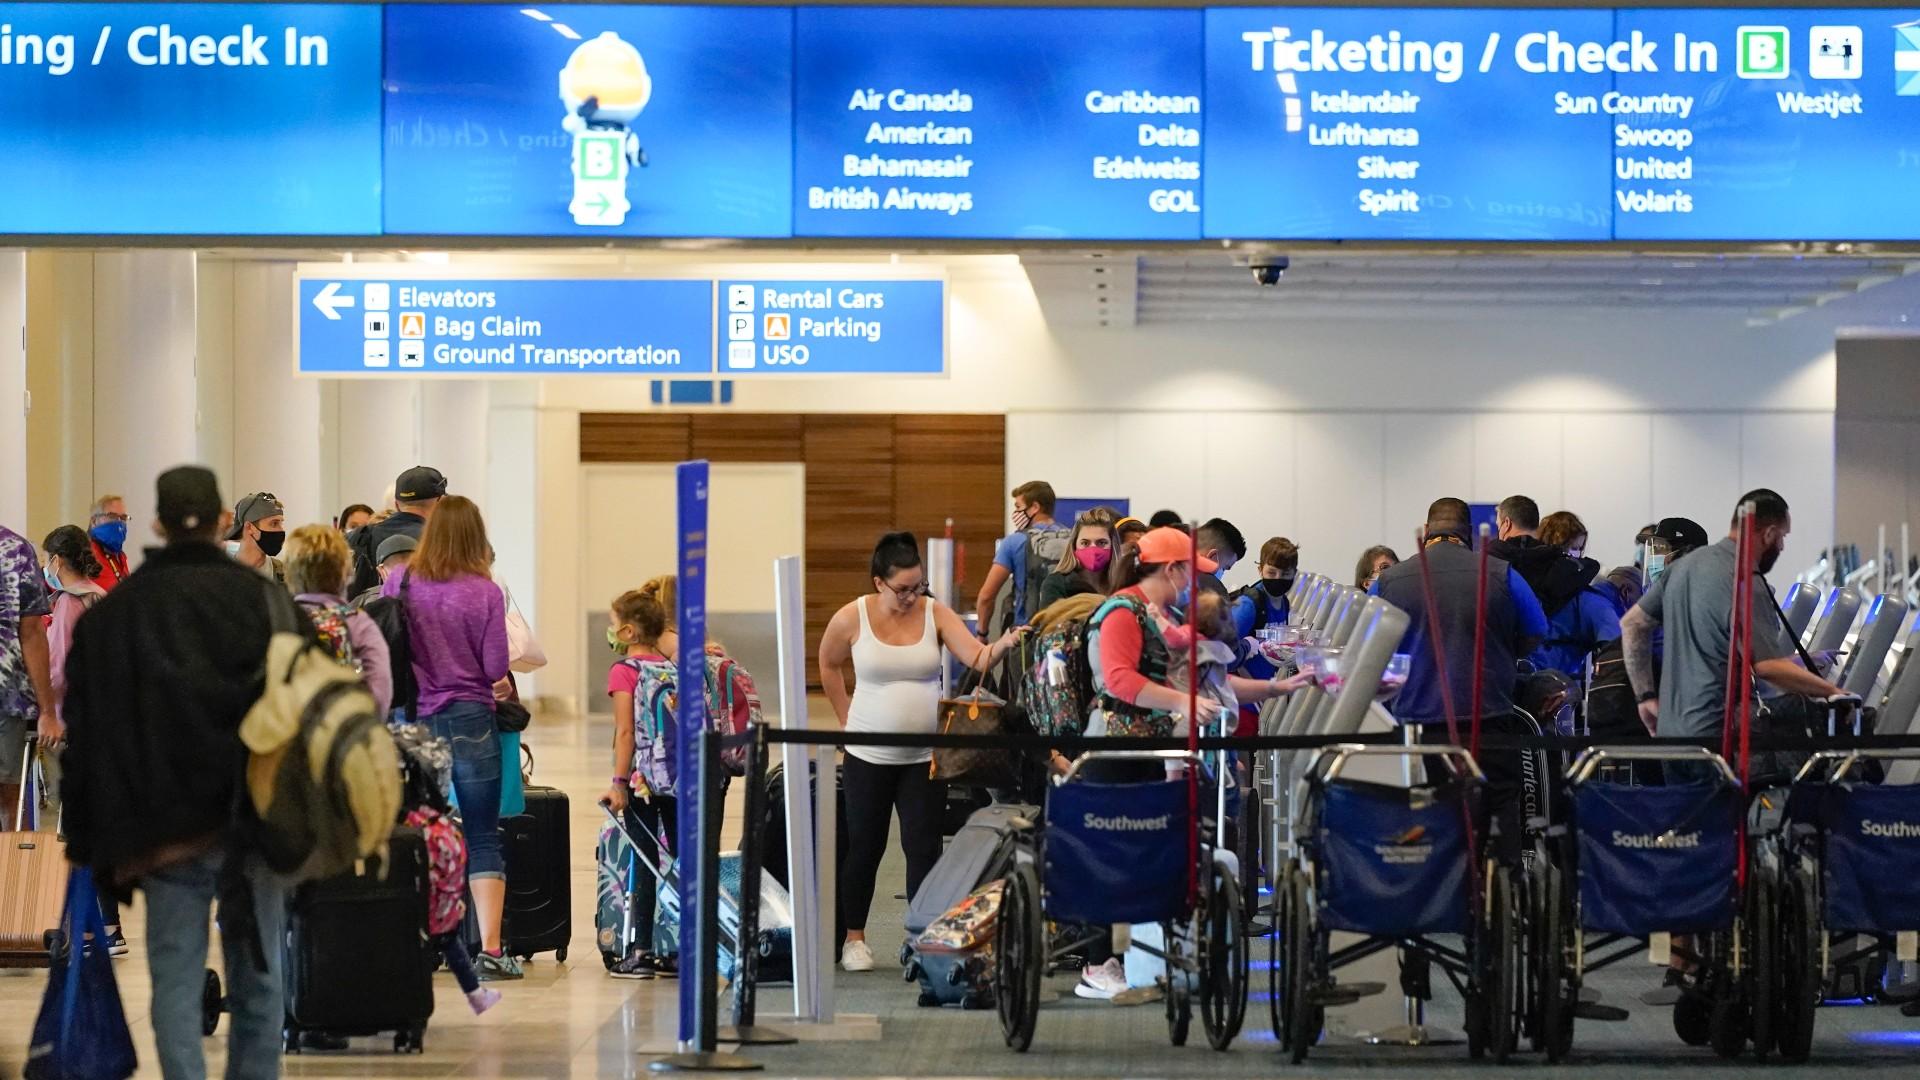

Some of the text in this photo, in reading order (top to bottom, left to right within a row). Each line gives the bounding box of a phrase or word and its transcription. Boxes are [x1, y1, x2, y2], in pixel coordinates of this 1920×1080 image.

[1, 23, 328, 75] ing / Check In
[1242, 29, 1778, 83] Ticketing / Check In B
[849, 89, 972, 112] Air Canada
[1085, 91, 1200, 114] Caribbean
[1311, 90, 1420, 113] Icelandair
[1555, 91, 1597, 114] Sun
[1602, 92, 1694, 118] Country
[1776, 91, 1862, 119] Westjet
[866, 122, 972, 145] American
[1138, 123, 1200, 147] Delta
[1309, 122, 1419, 146] Lufthansa
[1615, 123, 1693, 151] Swoop
[585, 140, 614, 177] B
[844, 154, 973, 178] Bahamasair
[1093, 156, 1200, 180] Edelweiss
[1358, 156, 1419, 179] Silver
[1616, 157, 1692, 180] United
[809, 187, 973, 216] British Airways
[1149, 189, 1200, 213] GOL
[1359, 189, 1419, 216] Spirit
[1616, 189, 1693, 213] Volaris
[399, 286, 496, 308] Elevators
[763, 287, 884, 309] Rental Cars
[403, 315, 541, 341] A Bag Claim
[768, 317, 787, 337] A
[799, 316, 881, 343] Parking
[433, 343, 681, 369] Ground Transportation
[763, 344, 810, 365] USO
[1083, 812, 1168, 831] Southwest
